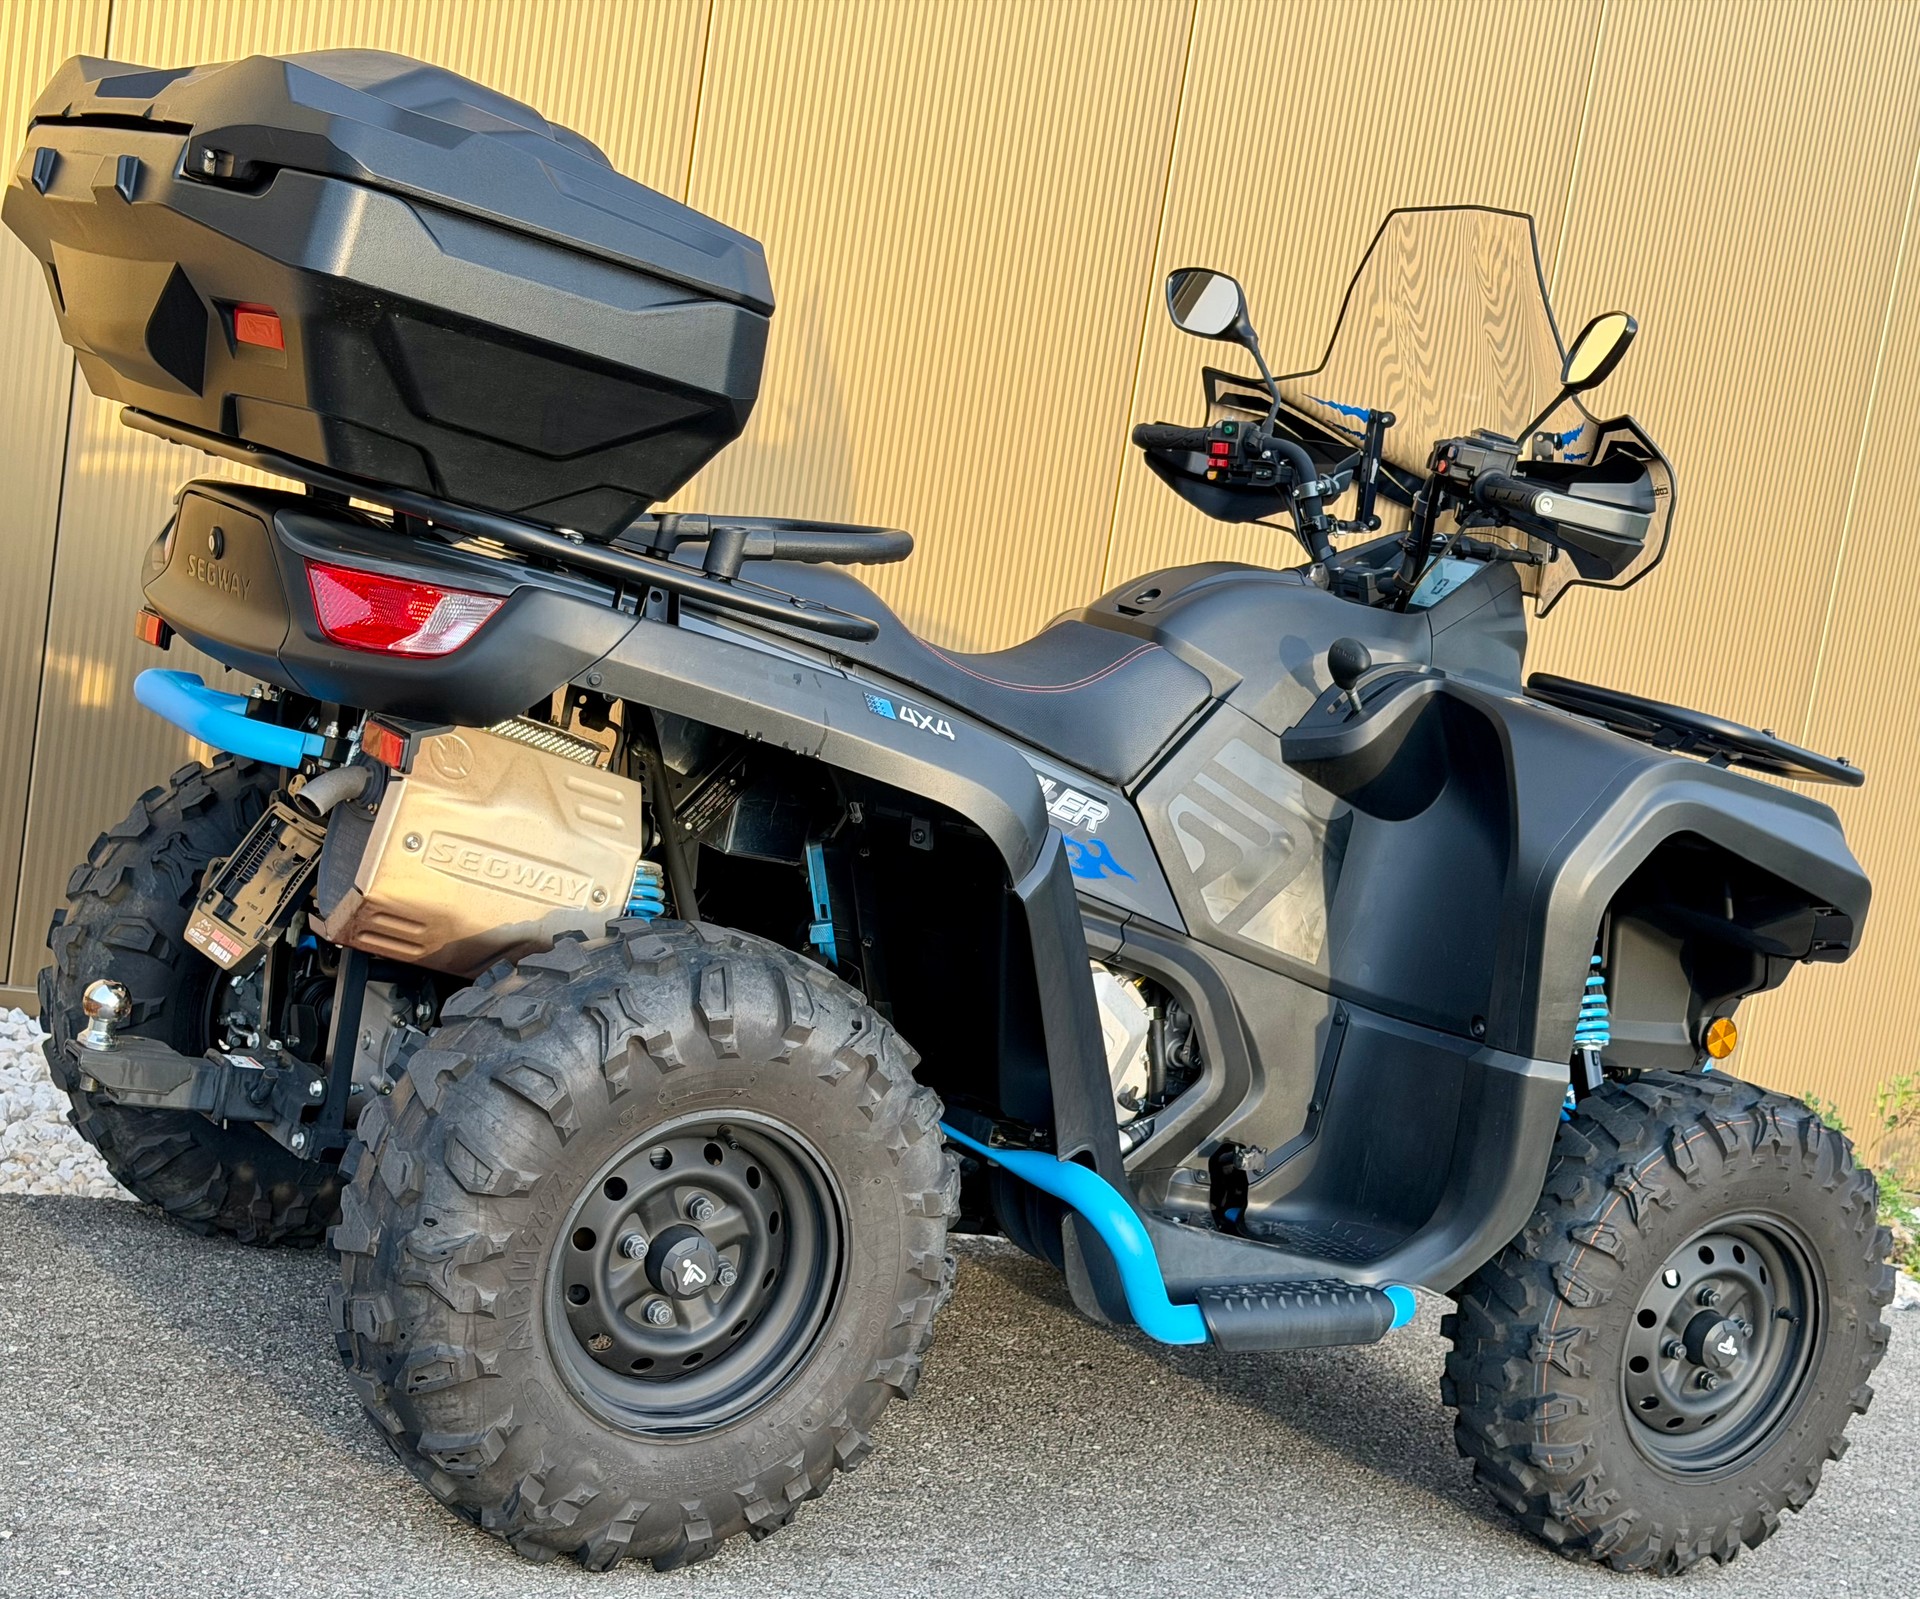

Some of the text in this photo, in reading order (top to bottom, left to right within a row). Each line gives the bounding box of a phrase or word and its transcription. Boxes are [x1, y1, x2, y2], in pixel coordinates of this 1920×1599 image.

[186, 554, 252, 601] SEGWAY
[1036, 774, 1110, 834] LER
[428, 842, 589, 901] SEGWAY
